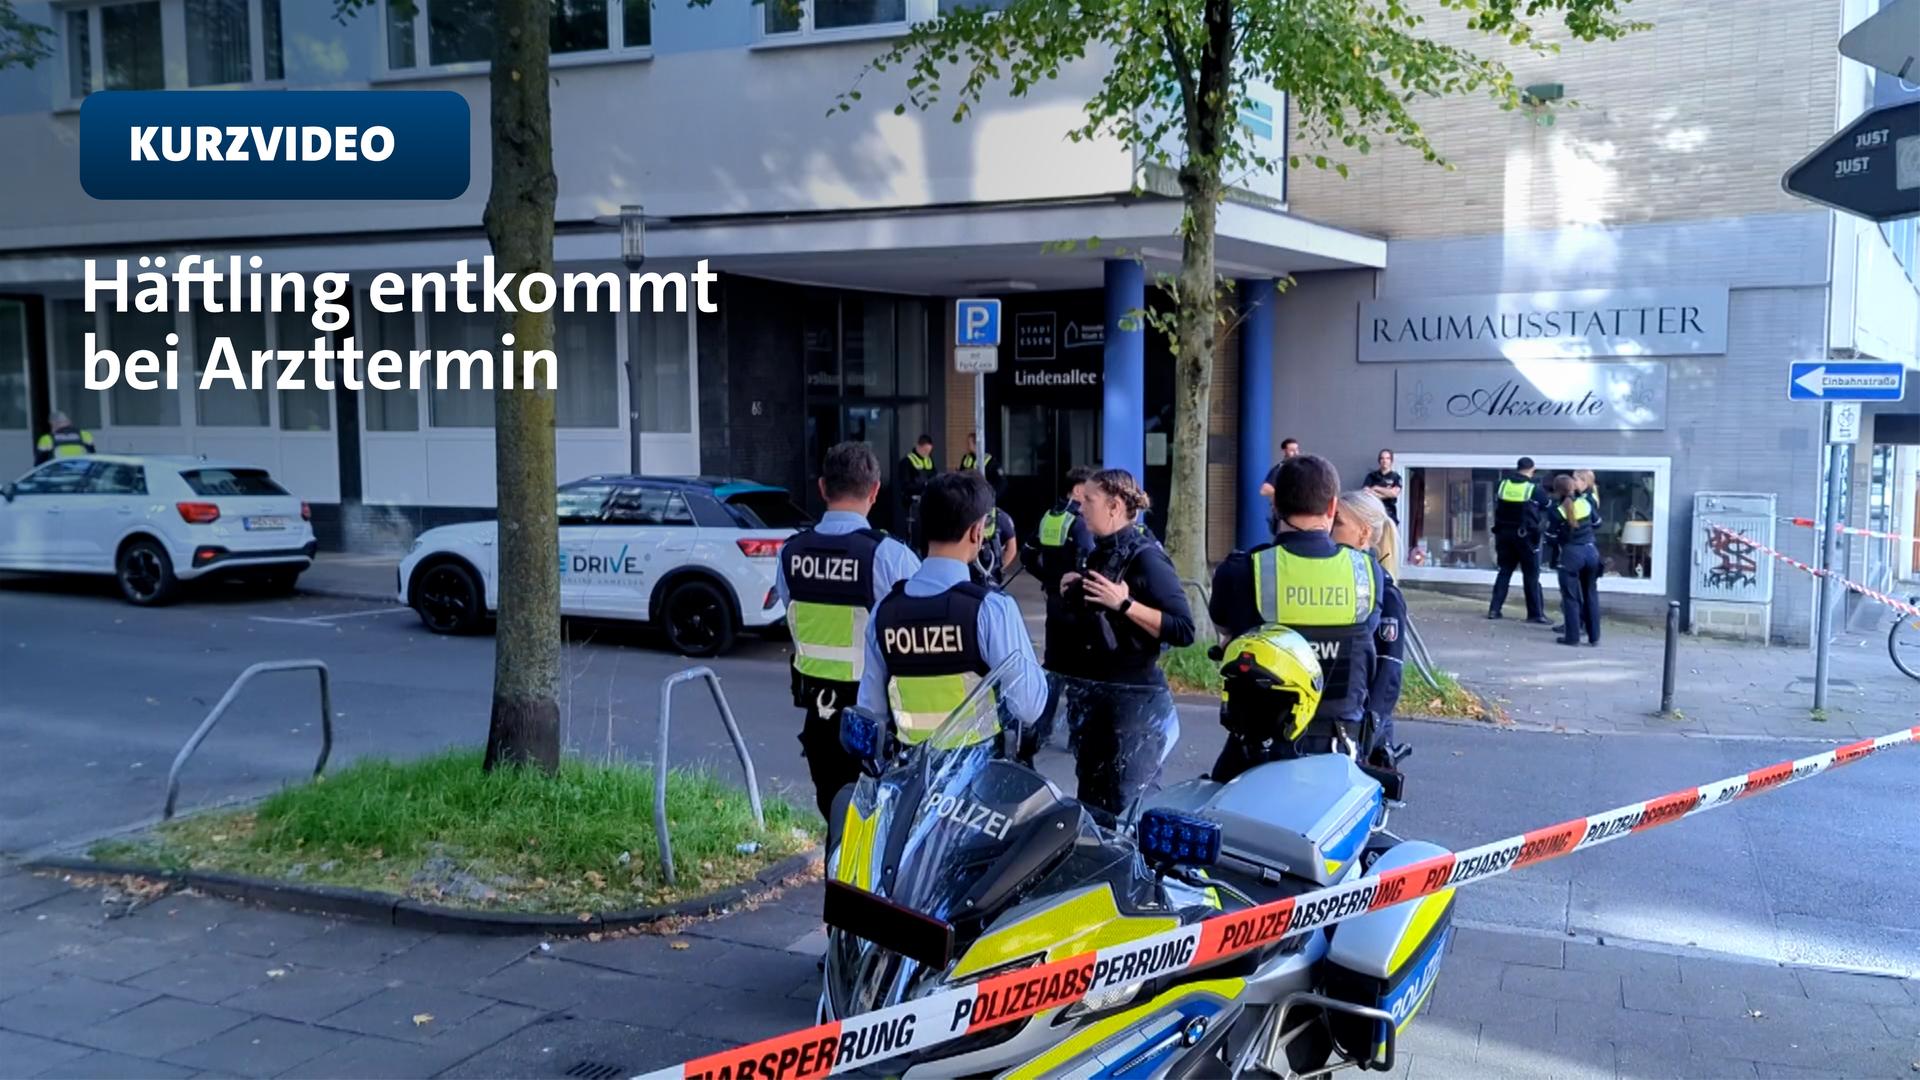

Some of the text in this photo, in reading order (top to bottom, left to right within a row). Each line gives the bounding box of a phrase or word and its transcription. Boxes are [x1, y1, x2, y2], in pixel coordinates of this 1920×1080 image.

[1856, 129, 1890, 147] JUST
[1835, 156, 1870, 174] JUST
[967, 306, 989, 340] P
[1373, 306, 1705, 343] RAUMAUSSTATTER
[1015, 368, 1097, 386] Lindenallee
[1822, 376, 1897, 386] Einbahnstraße
[1446, 379, 1604, 417] Akzente
[573, 544, 644, 574] DRIVE
[791, 556, 859, 581] POLIZEI
[1286, 586, 1349, 606] POLIZEI
[885, 625, 963, 655] POLIZEI
[1309, 641, 1340, 660] RW
[924, 792, 1013, 841] POLIZEI
[1421, 831, 1573, 895] POLIZEIABSPERRUNG
[1217, 877, 1407, 953] POLIZEIABSPERRUNG
[950, 934, 1196, 1032] POLIZEIABSPERRUNG
